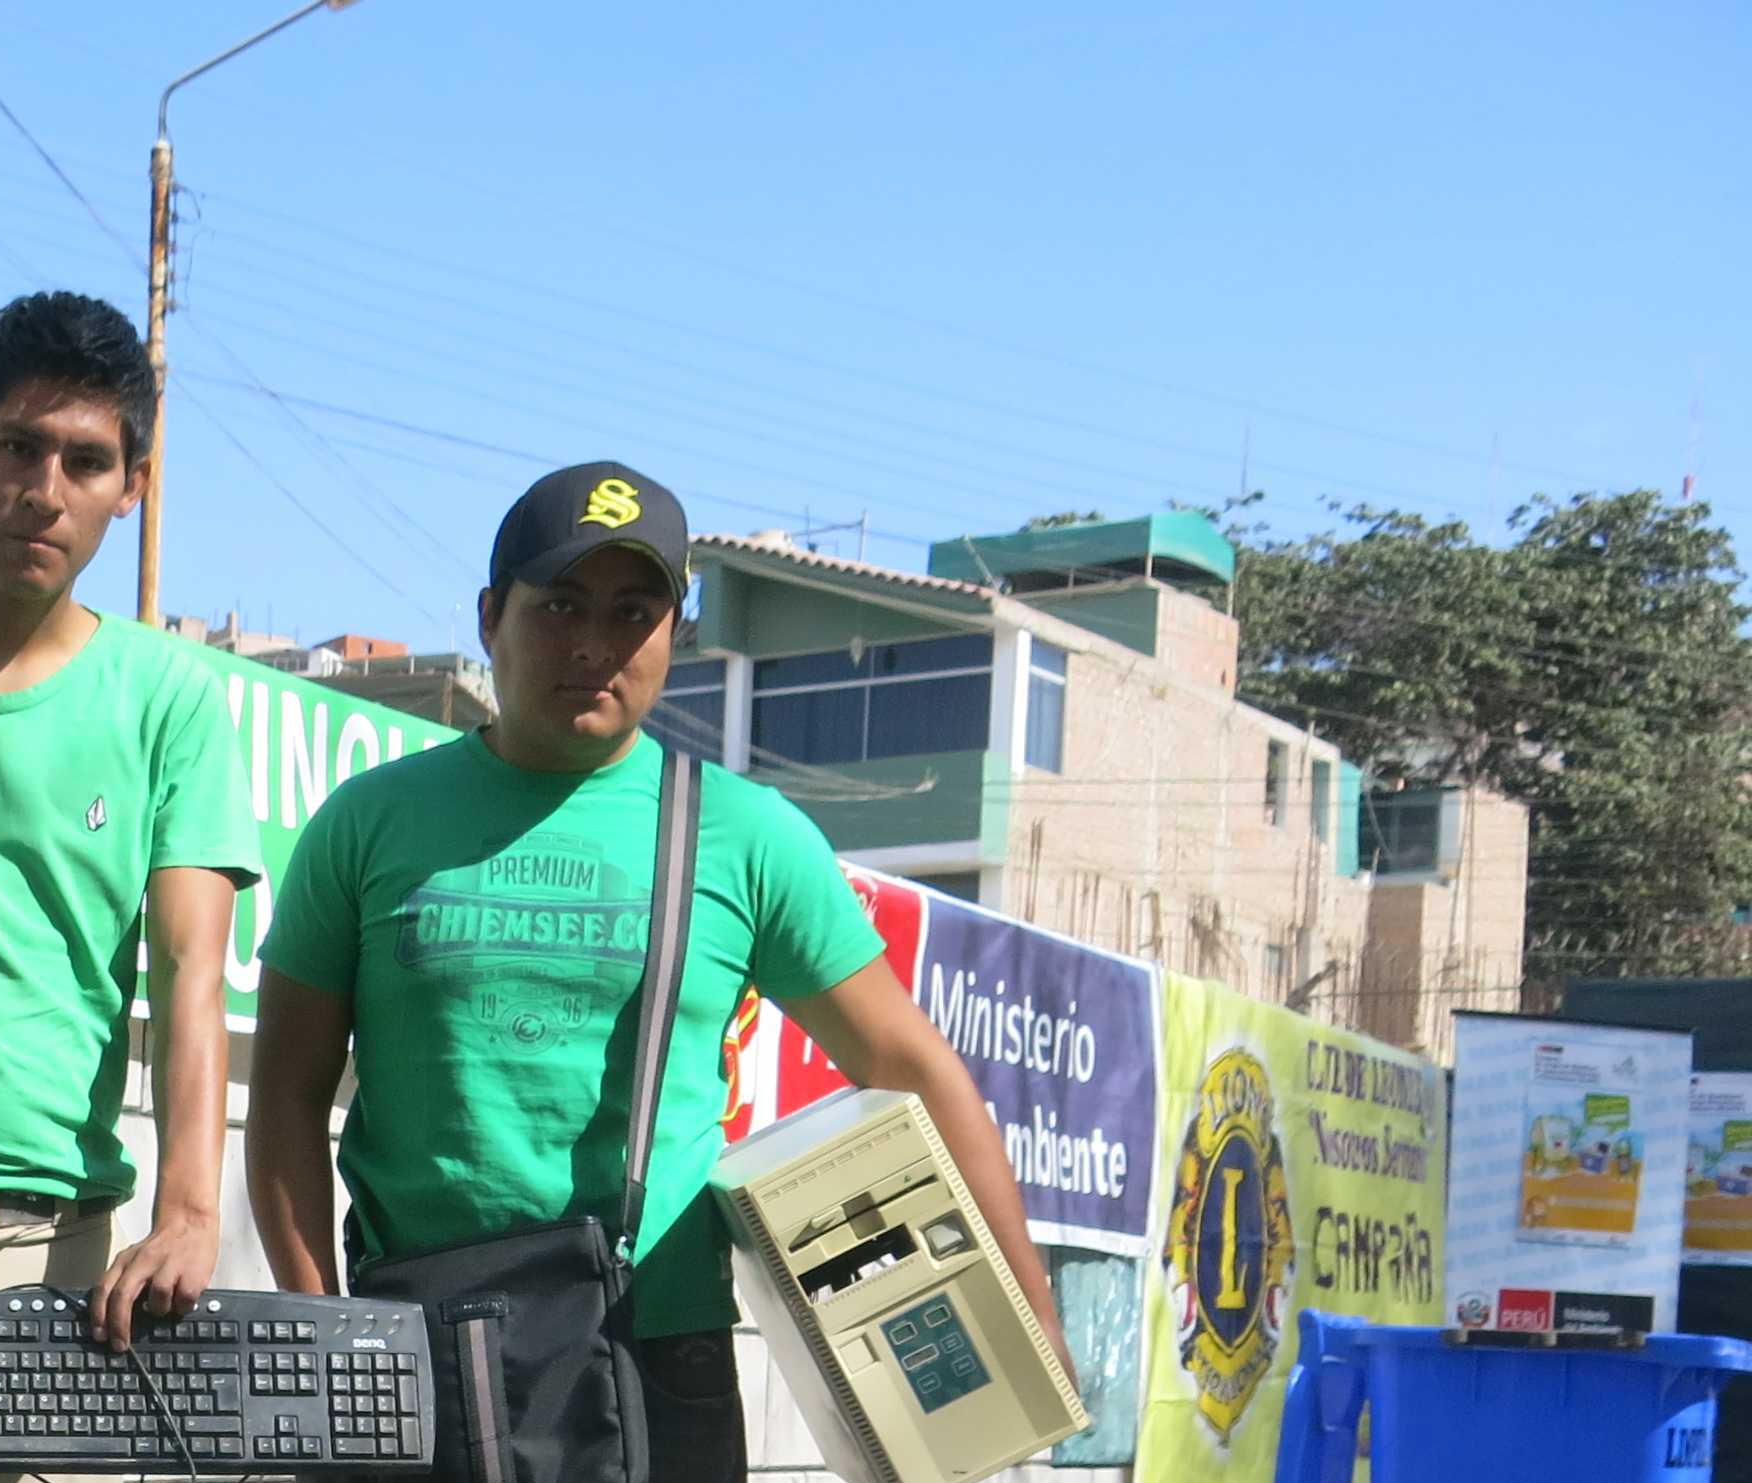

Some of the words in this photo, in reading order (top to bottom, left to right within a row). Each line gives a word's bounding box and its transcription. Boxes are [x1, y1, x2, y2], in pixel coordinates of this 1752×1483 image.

[488, 855, 596, 892] PREMIUM
[415, 902, 652, 951] CHIEMSEE.CO
[480, 992, 497, 1020] 19
[561, 998, 582, 1024] 96
[930, 962, 1095, 1083] Ministerio
[986, 1101, 1127, 1198] mbiente
